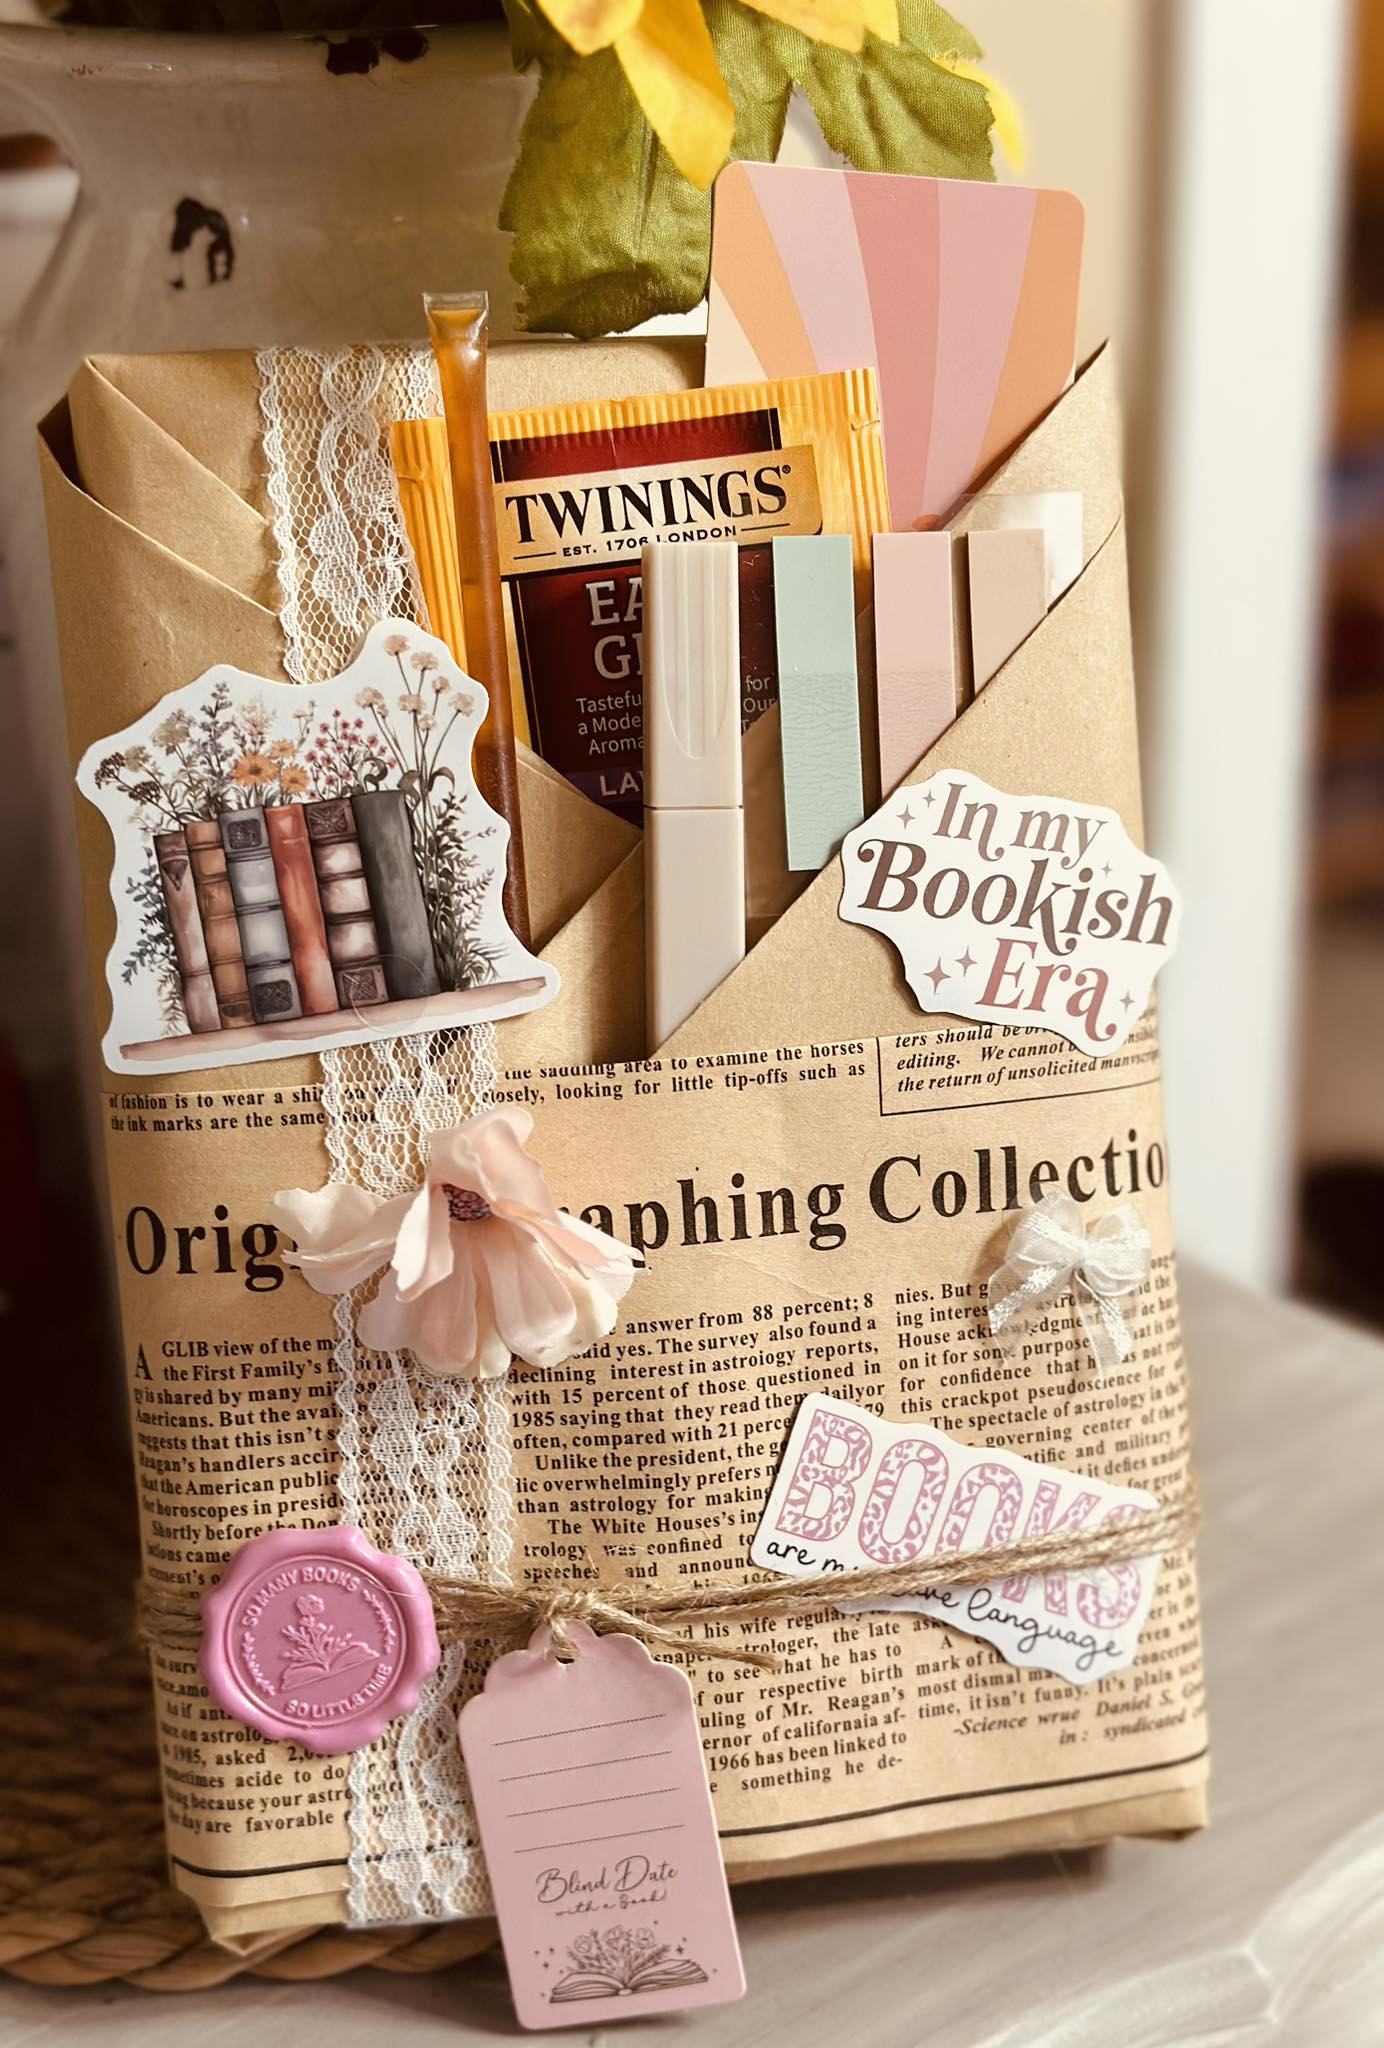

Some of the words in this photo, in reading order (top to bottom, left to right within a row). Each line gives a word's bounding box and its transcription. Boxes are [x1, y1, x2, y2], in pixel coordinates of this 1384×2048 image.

[563, 545, 597, 557] EST.
[576, 691, 642, 713] Tastefu
[746, 675, 770, 692] for
[578, 722, 588, 735] a
[593, 713, 641, 733] Mode
[933, 782, 1004, 862] In
[1010, 809, 1108, 870] my
[857, 839, 1173, 956] Bookish
[975, 937, 1117, 1042] Era
[936, 1024, 993, 1046] should
[696, 1051, 768, 1069] examine
[776, 1048, 802, 1061] the
[811, 1042, 864, 1058] horses
[897, 1053, 961, 1071] editing.
[1009, 1041, 1064, 1058] cannot
[557, 1082, 622, 1100] looking
[634, 1079, 660, 1094] for
[672, 1075, 713, 1092] little
[725, 1068, 788, 1091] tip-offs
[800, 1063, 837, 1080] such
[898, 1077, 924, 1093] the
[928, 1070, 983, 1090] return
[1008, 1055, 1098, 1081] unsolicited
[197, 1094, 213, 1108] to
[222, 1091, 264, 1107] wear
[153, 1116, 202, 1131] marks
[211, 1116, 238, 1130] are
[247, 1112, 273, 1127] the
[280, 1111, 325, 1126] same
[895, 1288, 934, 1304] nies.
[942, 1282, 972, 1299] But
[626, 1318, 693, 1334] answer
[699, 1312, 743, 1328] from
[753, 1304, 773, 1321] 88
[783, 1297, 858, 1321] percent;
[896, 1312, 923, 1328] ing
[162, 1341, 209, 1358] GLIB
[214, 1341, 254, 1357] view
[283, 1337, 311, 1352] the
[616, 1345, 652, 1361] yes.
[656, 1338, 693, 1354] The
[699, 1332, 759, 1350] survey
[769, 1325, 803, 1341] also
[809, 1317, 861, 1336] found
[898, 1332, 950, 1348] House
[509, 1367, 596, 1385] declining
[611, 1360, 684, 1380] interest
[806, 1340, 879, 1361] reports,
[943, 1350, 968, 1365] for
[163, 1367, 188, 1381] the
[193, 1365, 235, 1381] First
[593, 1385, 665, 1407] percent
[699, 1380, 747, 1396] those
[756, 1362, 854, 1391] questioned
[900, 1377, 925, 1392] for
[940, 1366, 1032, 1387] confidence
[1047, 1360, 1080, 1375] that
[157, 1389, 213, 1406] shared
[248, 1383, 301, 1403] many
[901, 1397, 932, 1414] this
[942, 1388, 1018, 1408] crackpot
[1028, 1372, 1142, 1403] pseudoscience
[220, 1411, 255, 1427] But
[260, 1408, 291, 1423] the
[512, 1411, 555, 1428] 1985
[560, 1410, 621, 1429] saying
[626, 1408, 664, 1424] that
[720, 1396, 760, 1415] read
[968, 1401, 1048, 1429] spectacle
[1074, 1392, 1146, 1415] astrology
[513, 1434, 567, 1450] often,
[572, 1429, 666, 1450] compared
[672, 1426, 712, 1443] with
[1082, 1417, 1132, 1436] center
[192, 1435, 229, 1450] that
[235, 1431, 272, 1447] this
[1075, 1440, 1105, 1459] and
[1115, 1430, 1171, 1452] military
[200, 1454, 285, 1472] handlers
[536, 1455, 597, 1470] Unlike
[603, 1452, 632, 1467] the
[637, 1449, 732, 1472] president,
[737, 1442, 765, 1458] the
[1104, 1458, 1147, 1476] defies
[185, 1478, 274, 1495] American
[280, 1473, 338, 1491] public
[543, 1473, 691, 1492] overwhelmingly
[697, 1467, 761, 1489] prefers
[157, 1496, 249, 1522] horoscopes
[518, 1499, 559, 1513] than
[570, 1496, 657, 1515] astrology
[668, 1494, 695, 1509] for
[206, 1520, 263, 1540] before
[547, 1520, 582, 1534] The
[592, 1518, 646, 1533] White
[647, 1535, 722, 1555] confined
[258, 1569, 298, 1606] MANY
[301, 1567, 361, 1592] BOOKS
[767, 1542, 816, 1567] are
[968, 1587, 1122, 1671] language
[704, 1623, 730, 1640] his
[740, 1617, 777, 1637] wife
[833, 1626, 860, 1644] the
[868, 1620, 900, 1639] late
[850, 1646, 877, 1664] has
[886, 1642, 902, 1656] to
[916, 1658, 960, 1677] mark
[966, 1651, 983, 1668] of
[714, 1689, 745, 1705] our
[759, 1674, 847, 1700] respective
[861, 1663, 904, 1686] birth
[918, 1679, 957, 1698] most
[963, 1669, 1022, 1690] dismal
[919, 1702, 961, 1720] time,
[1034, 1682, 1089, 1703] funny.
[1133, 1666, 1173, 1690] plain
[782, 1701, 813, 1719] Mr.
[828, 1686, 905, 1712] Reagan's
[1103, 1712, 1186, 1740] syndicated
[216, 1750, 265, 1766] asked
[708, 1752, 750, 1772] 1966
[755, 1751, 784, 1767] has
[789, 1743, 829, 1762] been
[833, 1732, 887, 1755] linked
[892, 1730, 907, 1744] to
[236, 1771, 283, 1787] acide
[741, 1767, 832, 1791] something
[877, 1753, 903, 1770] de-
[260, 1794, 303, 1813] your
[206, 1818, 232, 1834] are
[246, 1810, 334, 1833] favorable
[536, 1866, 610, 1904] Blind
[615, 1855, 679, 1892] Date
